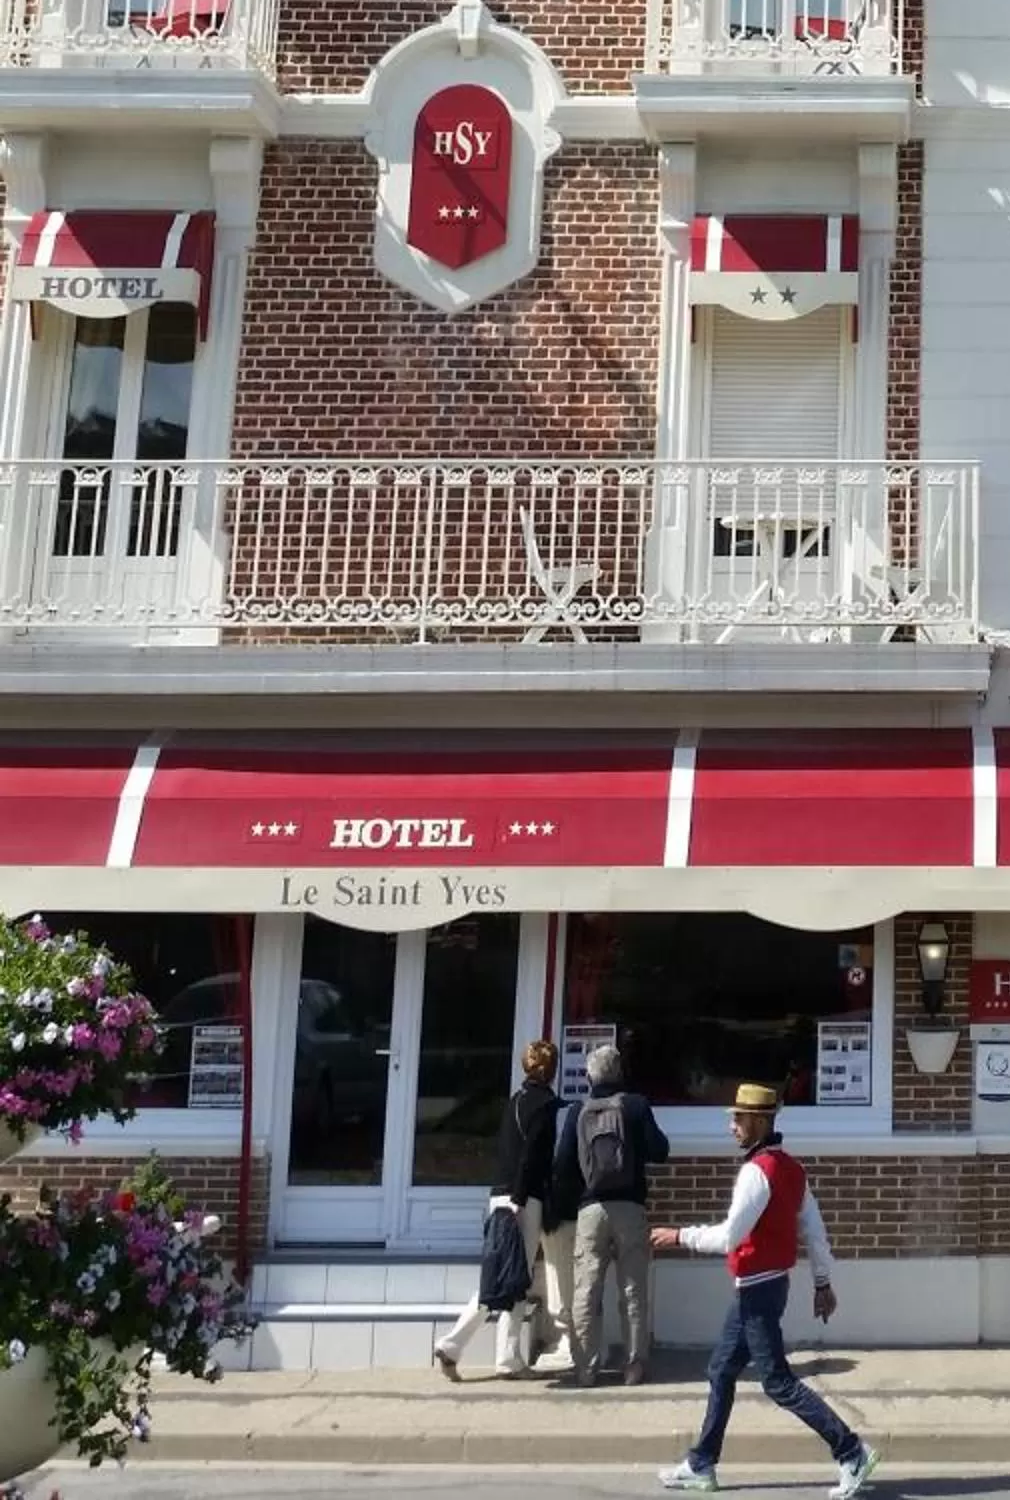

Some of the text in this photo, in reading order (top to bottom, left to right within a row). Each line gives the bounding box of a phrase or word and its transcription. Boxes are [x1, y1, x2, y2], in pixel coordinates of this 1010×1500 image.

[432, 120, 493, 165] HSY
[39, 277, 164, 299] HOTEL
[329, 818, 474, 848] HOTEL
[280, 875, 507, 906] Le Saint Yves
